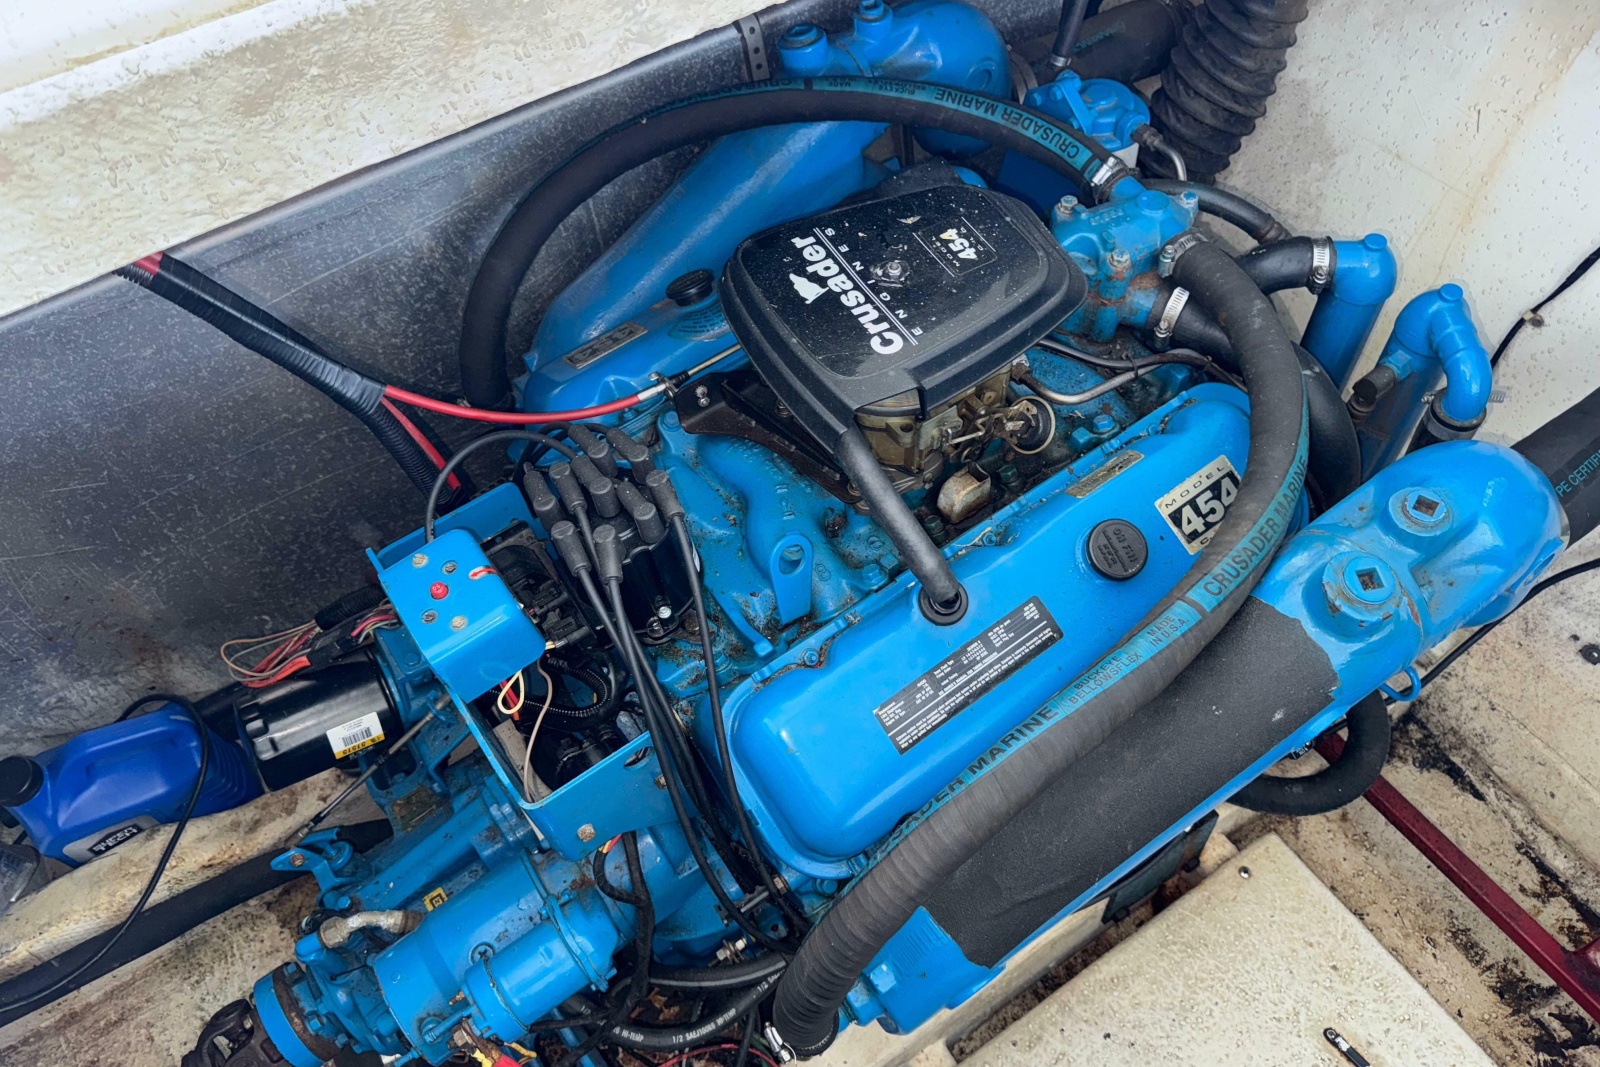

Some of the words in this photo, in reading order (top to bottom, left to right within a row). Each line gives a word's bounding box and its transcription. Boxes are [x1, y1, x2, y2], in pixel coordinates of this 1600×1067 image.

[934, 88, 1001, 122] MARINE
[1000, 105, 1080, 159] CRUSADER
[931, 236, 960, 268] MODEL
[938, 227, 978, 260] 454
[791, 235, 904, 355] Crusader
[824, 226, 925, 337] ENGINES
[1164, 465, 1225, 509] MODEL
[1179, 475, 1238, 537] 454
[1202, 517, 1280, 598] CRUSADER
[1274, 455, 1308, 518] MARINE
[1146, 613, 1176, 638] MADE
[1149, 635, 1163, 648] IN
[1161, 613, 1190, 639] U.S.A.
[1067, 649, 1143, 705] BELLOWSFLEX
[1072, 653, 1122, 691] BUCKEYE
[967, 705, 1060, 776] MARINE
[672, 1034, 684, 1044] 1/2
[717, 1007, 738, 1026] HI-TEMP
